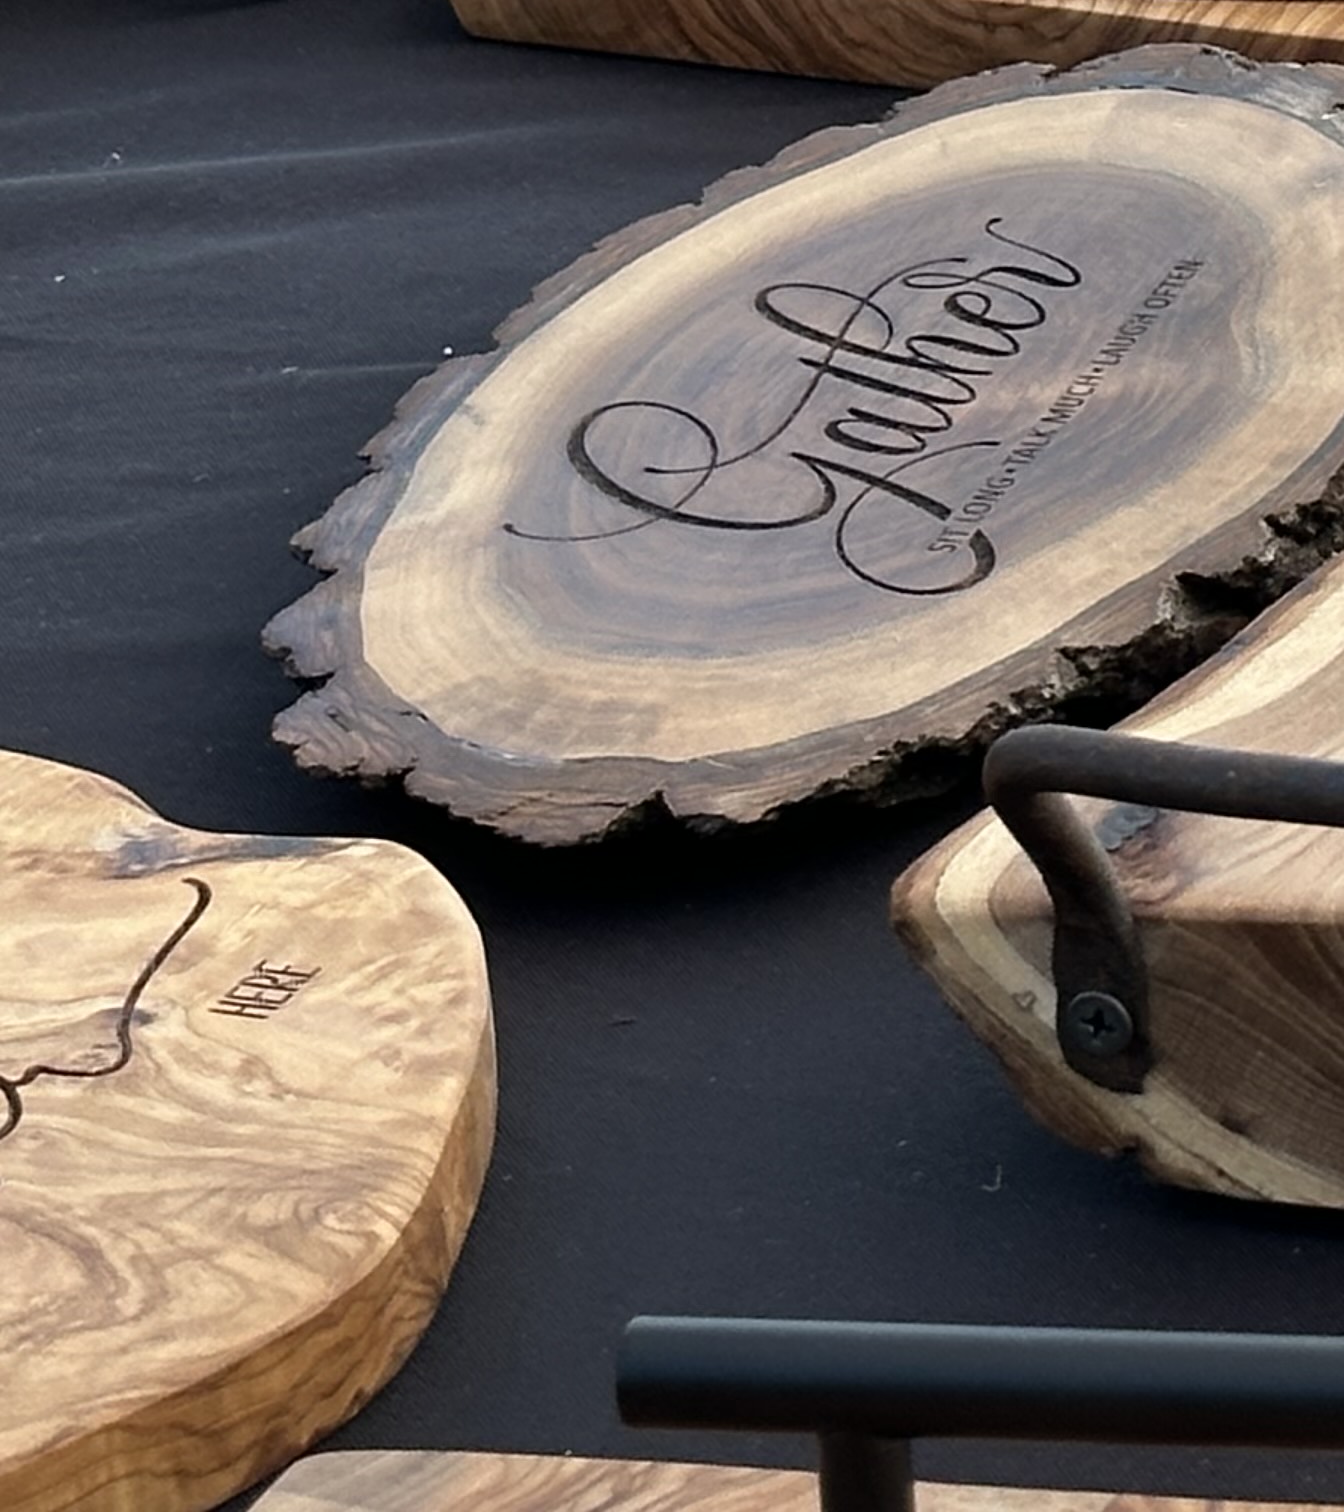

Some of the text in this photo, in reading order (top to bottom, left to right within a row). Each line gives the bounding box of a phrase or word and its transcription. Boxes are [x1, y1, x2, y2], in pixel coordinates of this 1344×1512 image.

[503, 217, 1082, 595] Gather
[928, 259, 1204, 553] SIT LONG TALK MUCH LAUGH OFTEN
[207, 958, 323, 1021] HERE
